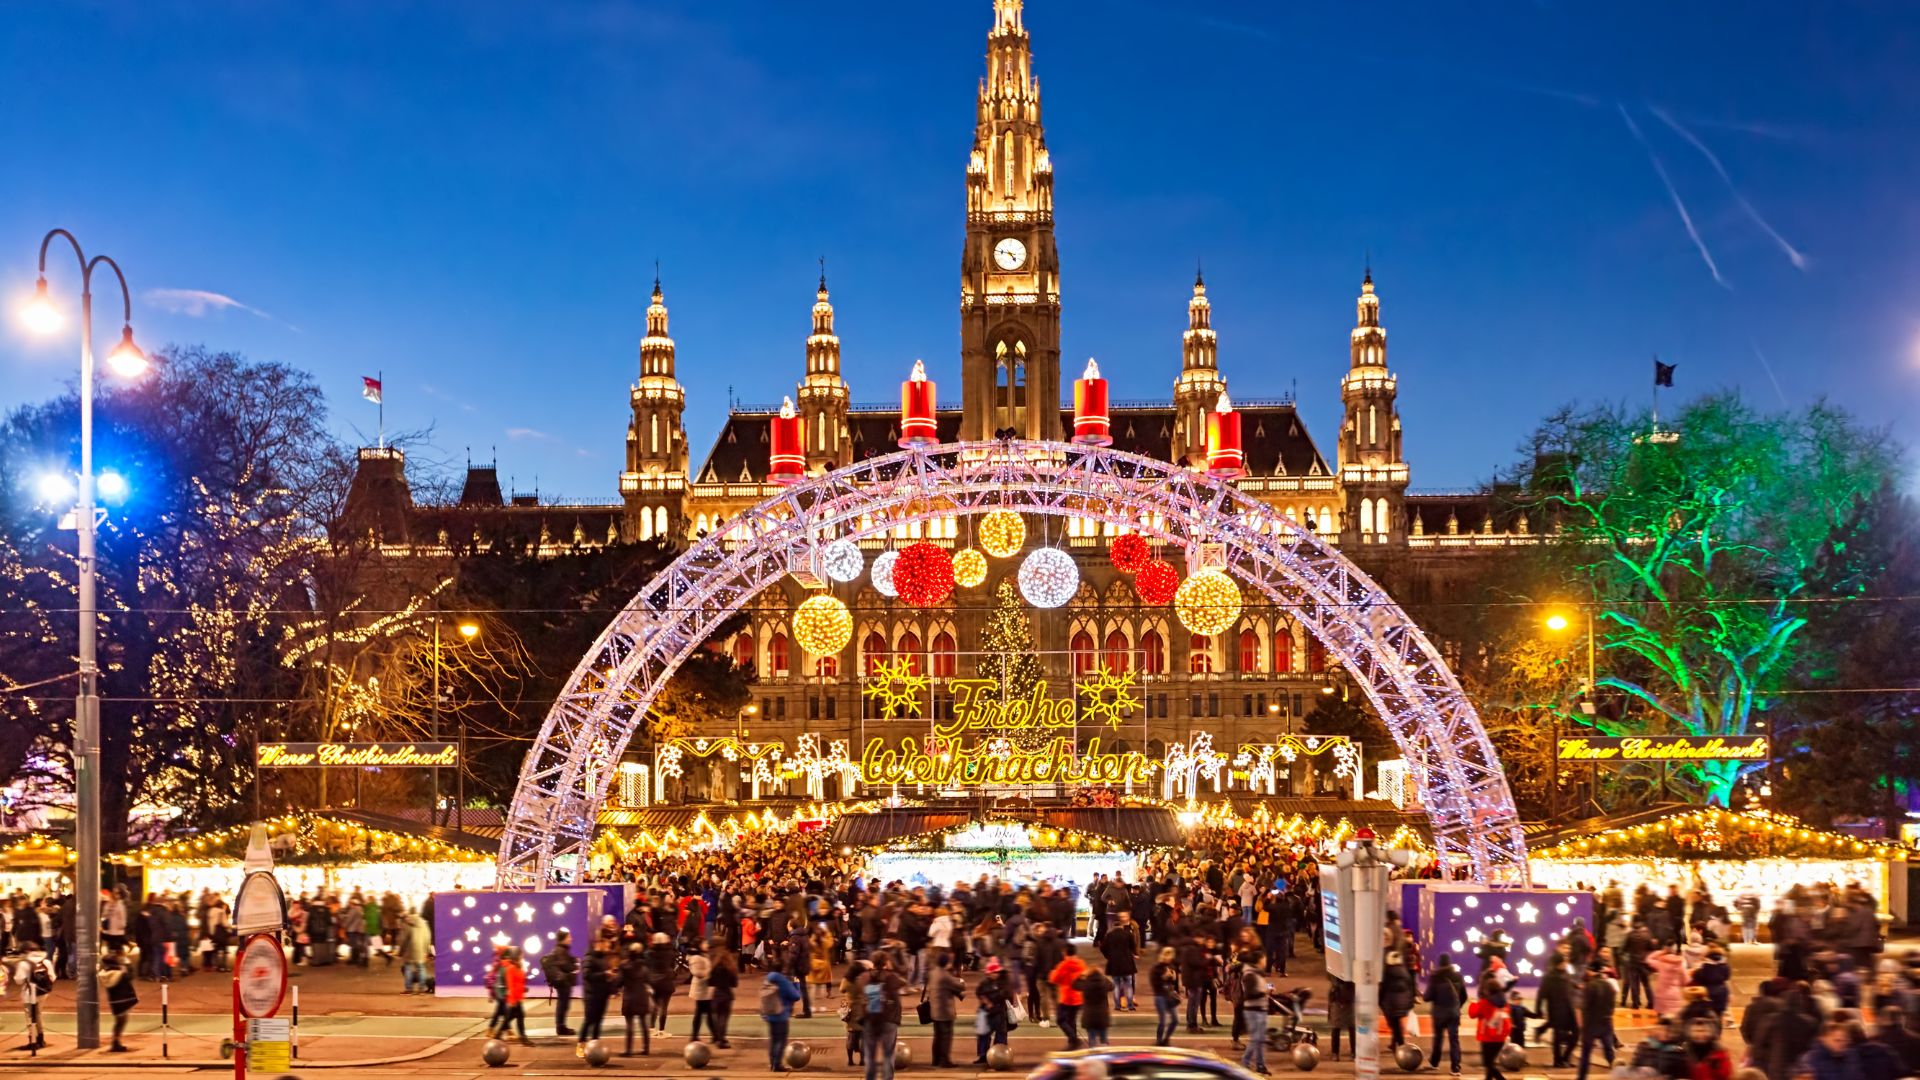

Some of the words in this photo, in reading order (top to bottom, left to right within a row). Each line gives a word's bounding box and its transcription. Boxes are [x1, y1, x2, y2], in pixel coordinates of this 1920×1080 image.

[935, 679, 1077, 737] Frohe
[257, 744, 315, 766] Wiener
[317, 743, 458, 765] Christkindlmarkt
[862, 737, 1148, 785] Weihnachten
[1558, 738, 1618, 759] Wiener
[1620, 737, 1768, 759] Christkindlmarkt
